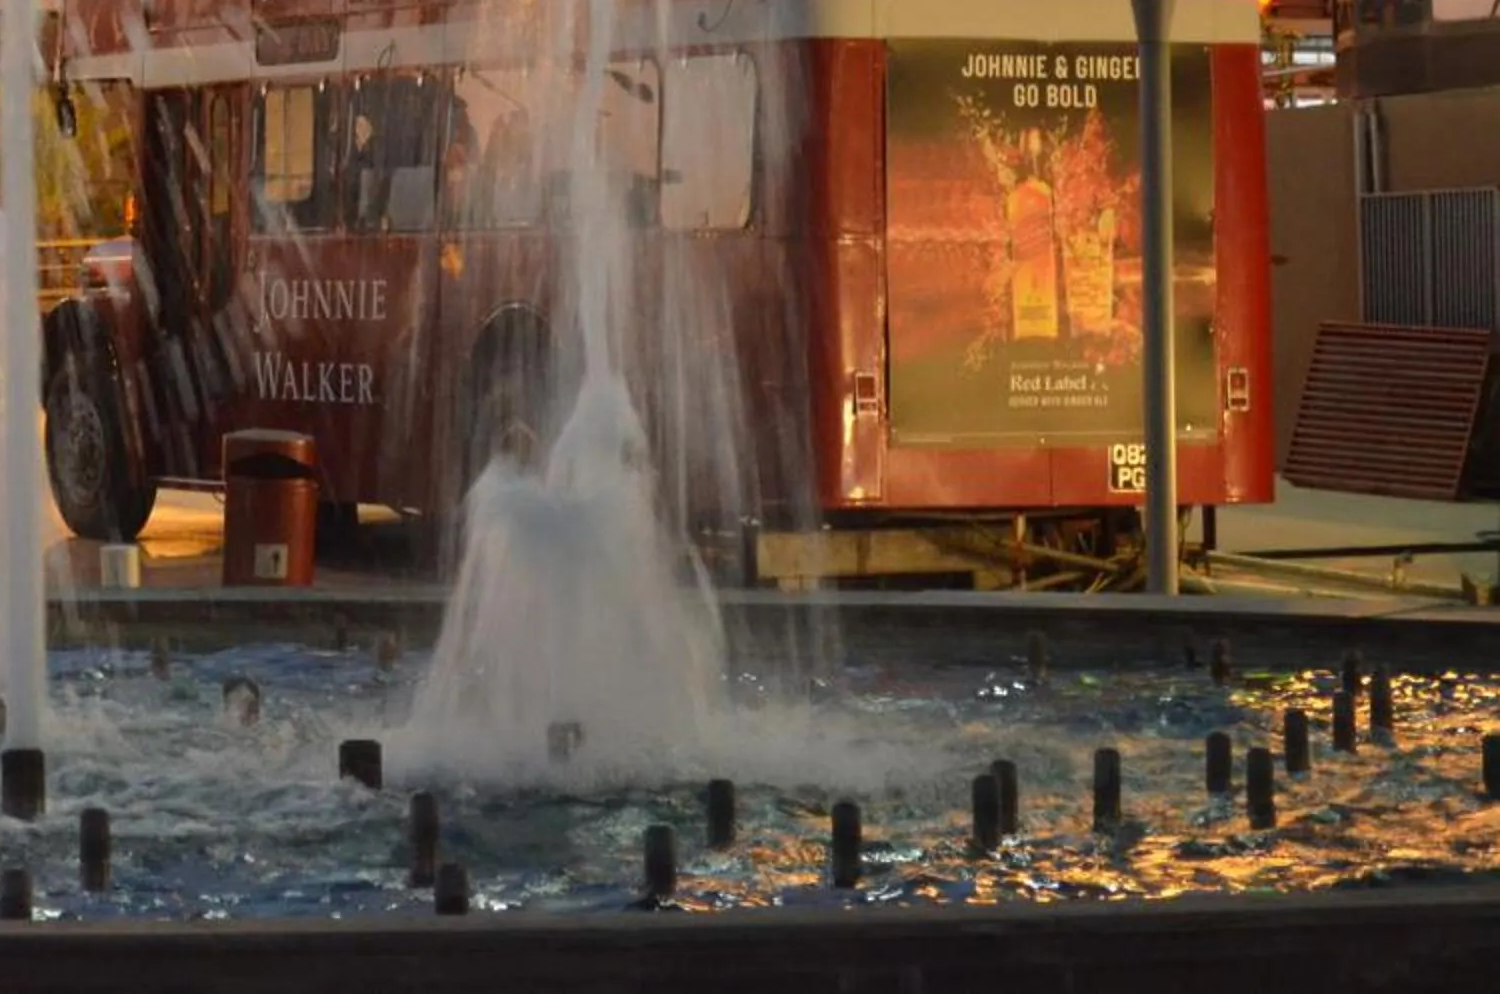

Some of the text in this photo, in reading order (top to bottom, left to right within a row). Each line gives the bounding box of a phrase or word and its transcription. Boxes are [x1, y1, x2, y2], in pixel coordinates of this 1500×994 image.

[961, 53, 1048, 79] JOHNNIE
[1055, 55, 1068, 79] &
[1013, 84, 1097, 109] GO BOLD
[253, 270, 388, 334] JOHNNIE
[1011, 374, 1087, 392] Red Label
